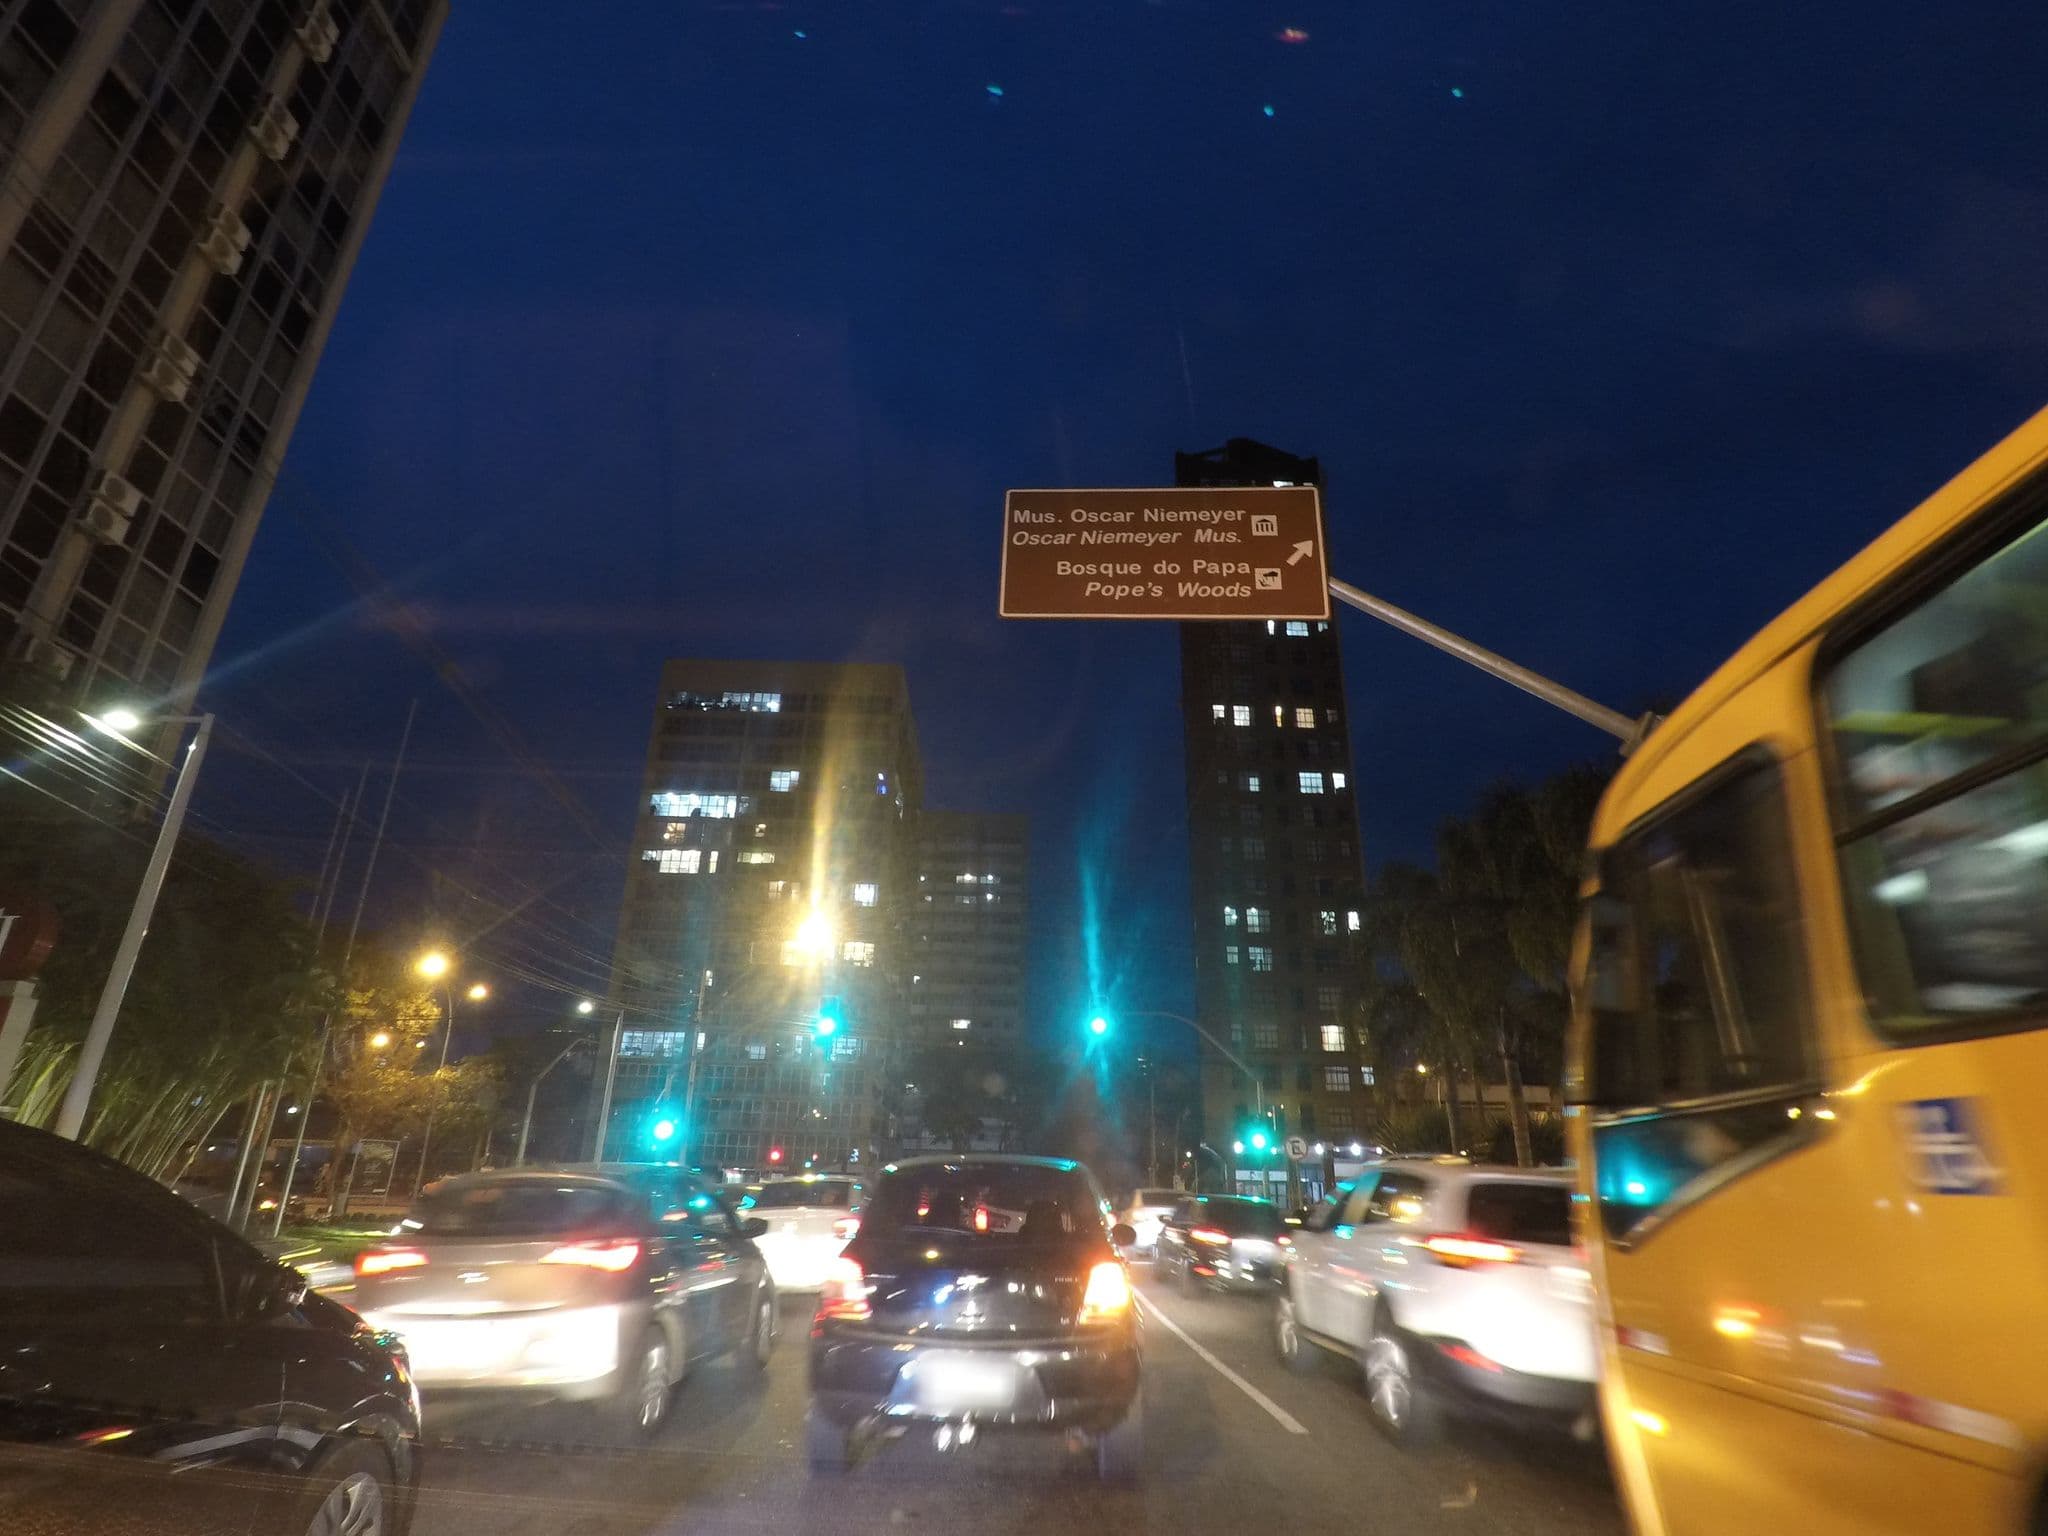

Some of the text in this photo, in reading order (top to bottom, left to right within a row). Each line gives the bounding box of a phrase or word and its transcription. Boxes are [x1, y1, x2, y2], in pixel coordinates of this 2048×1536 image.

[1013, 507, 1247, 525] Mus. Oscar Niemeyer
[1012, 527, 1242, 547] Oscar Niemeyer Mus.
[1056, 559, 1251, 578] Bosque do Papa
[1085, 581, 1252, 600] Pope's Woods
